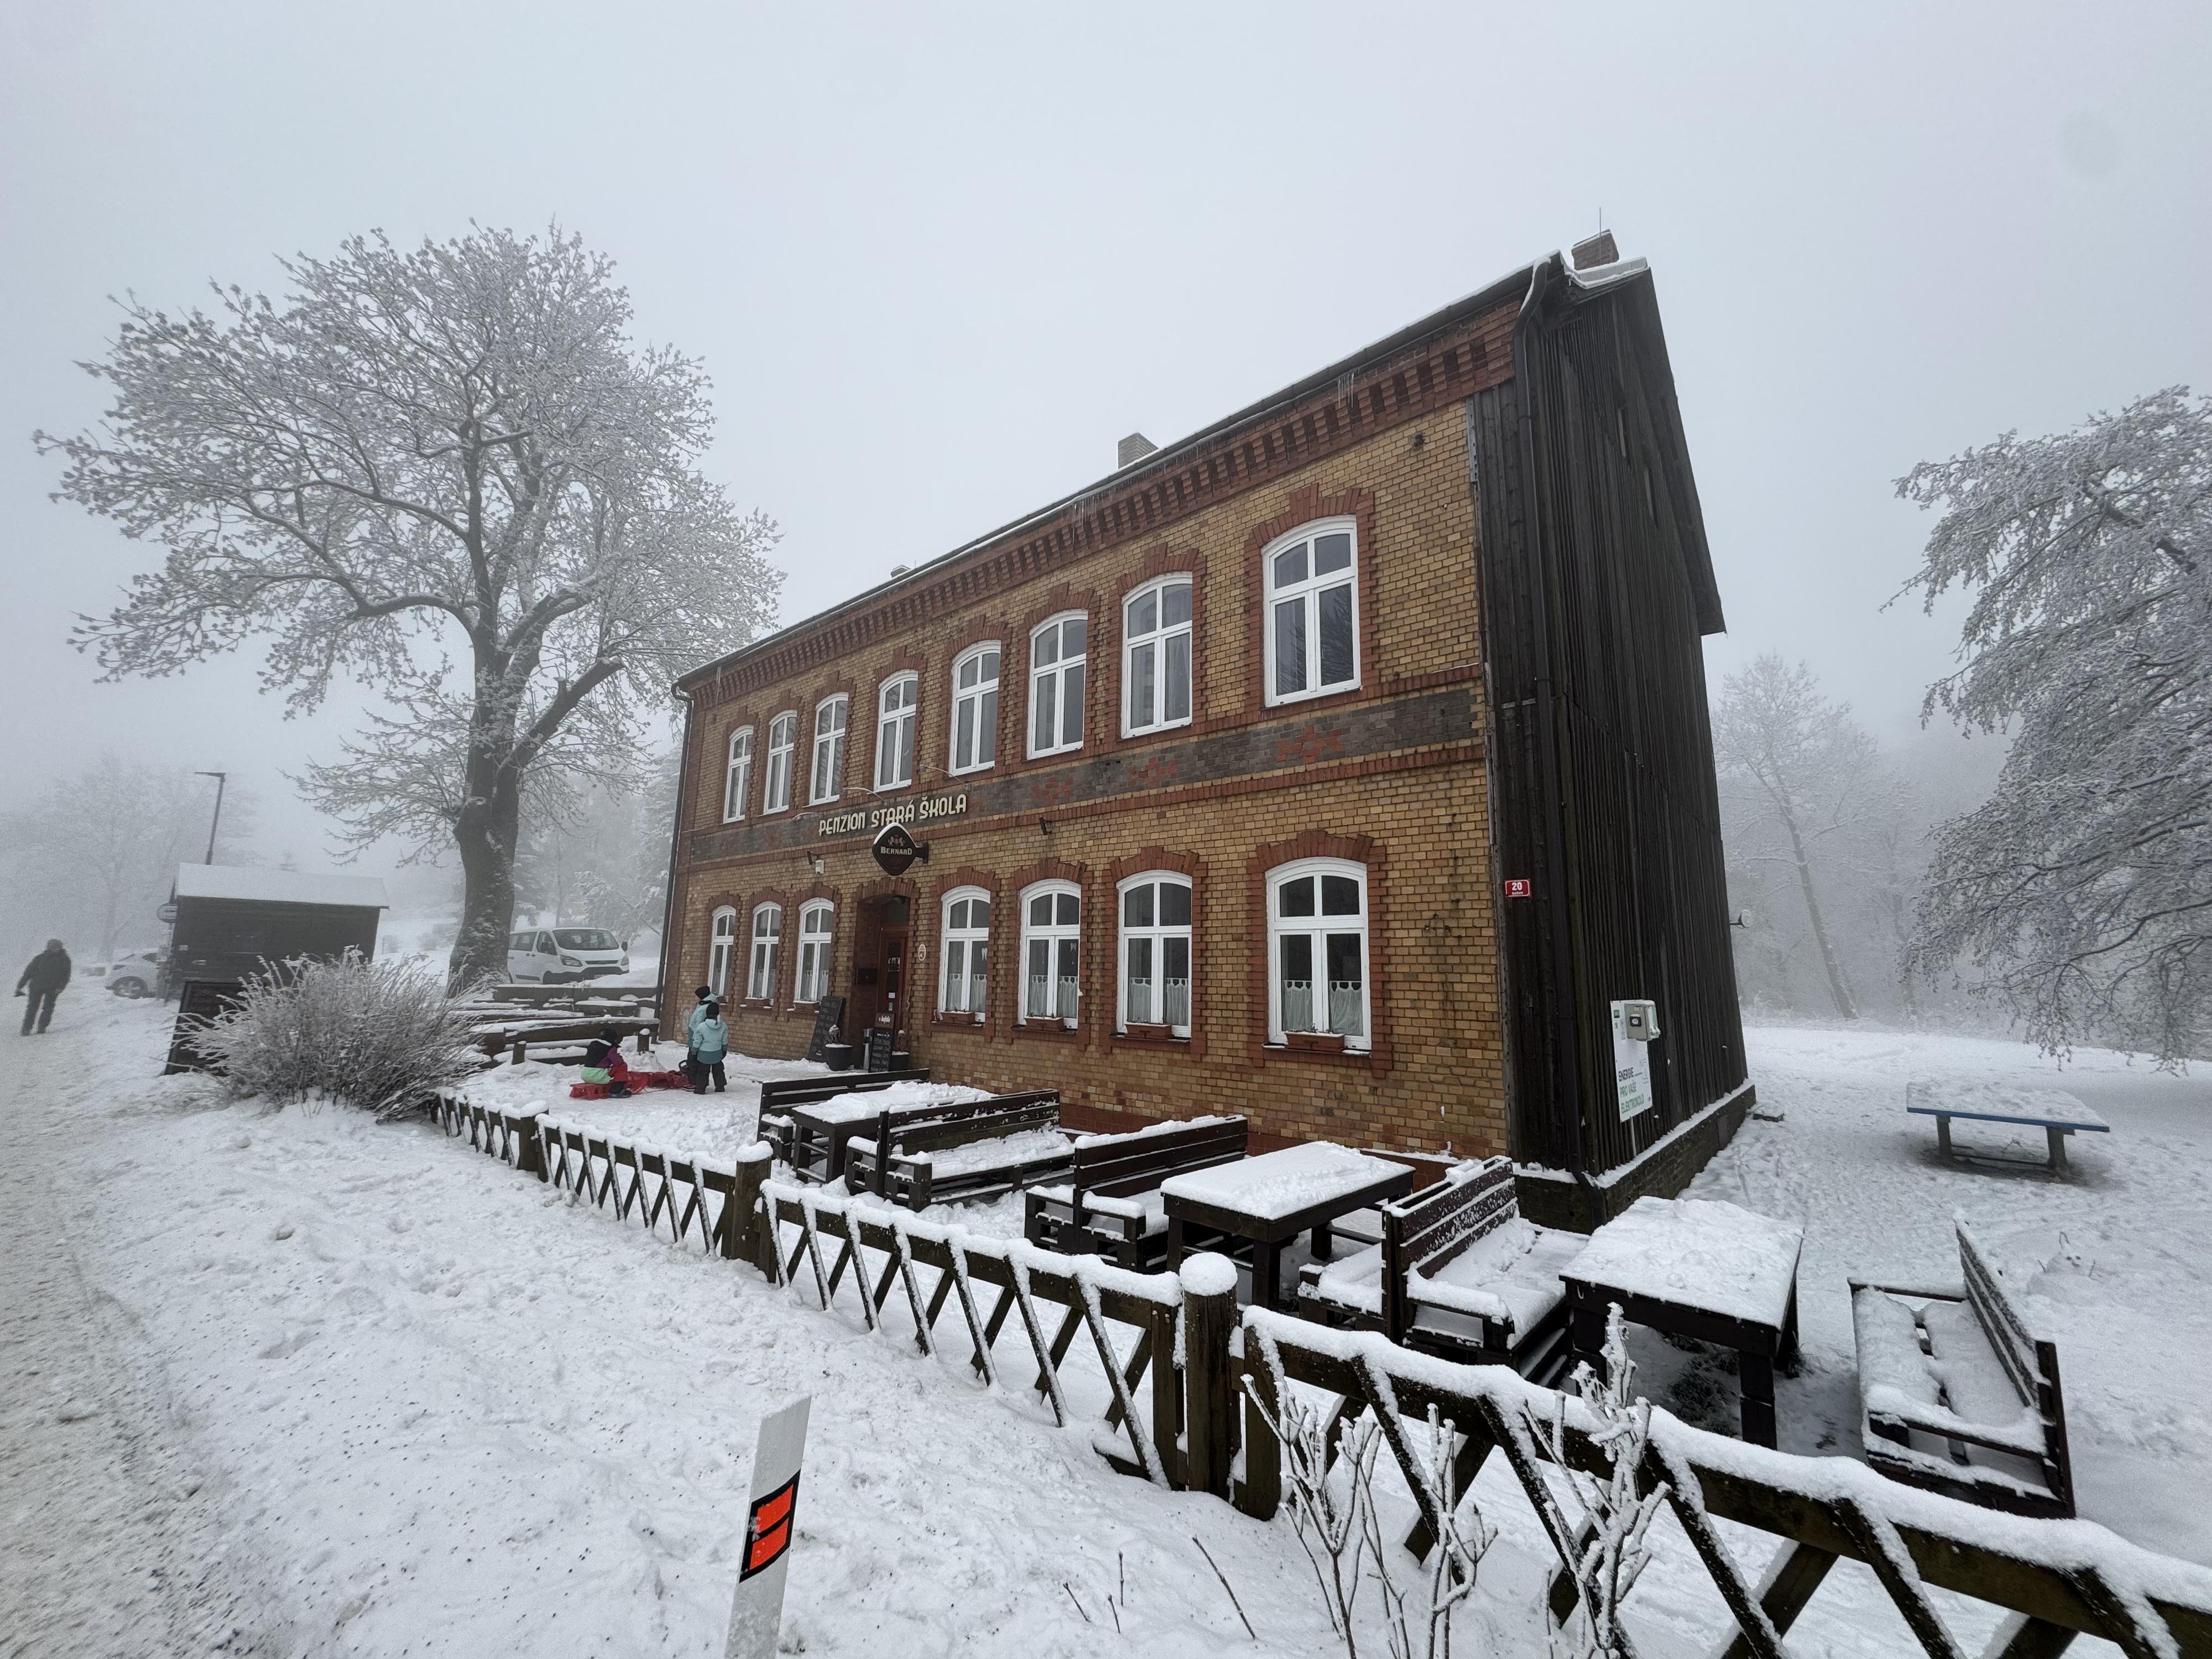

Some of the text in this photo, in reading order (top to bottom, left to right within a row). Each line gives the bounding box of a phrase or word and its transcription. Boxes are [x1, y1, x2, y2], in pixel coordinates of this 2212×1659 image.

[818, 794, 967, 836] PENZION STARÁ ŠKOLA
[880, 846, 912, 855] BERNARD
[1511, 882, 1522, 891] 20
